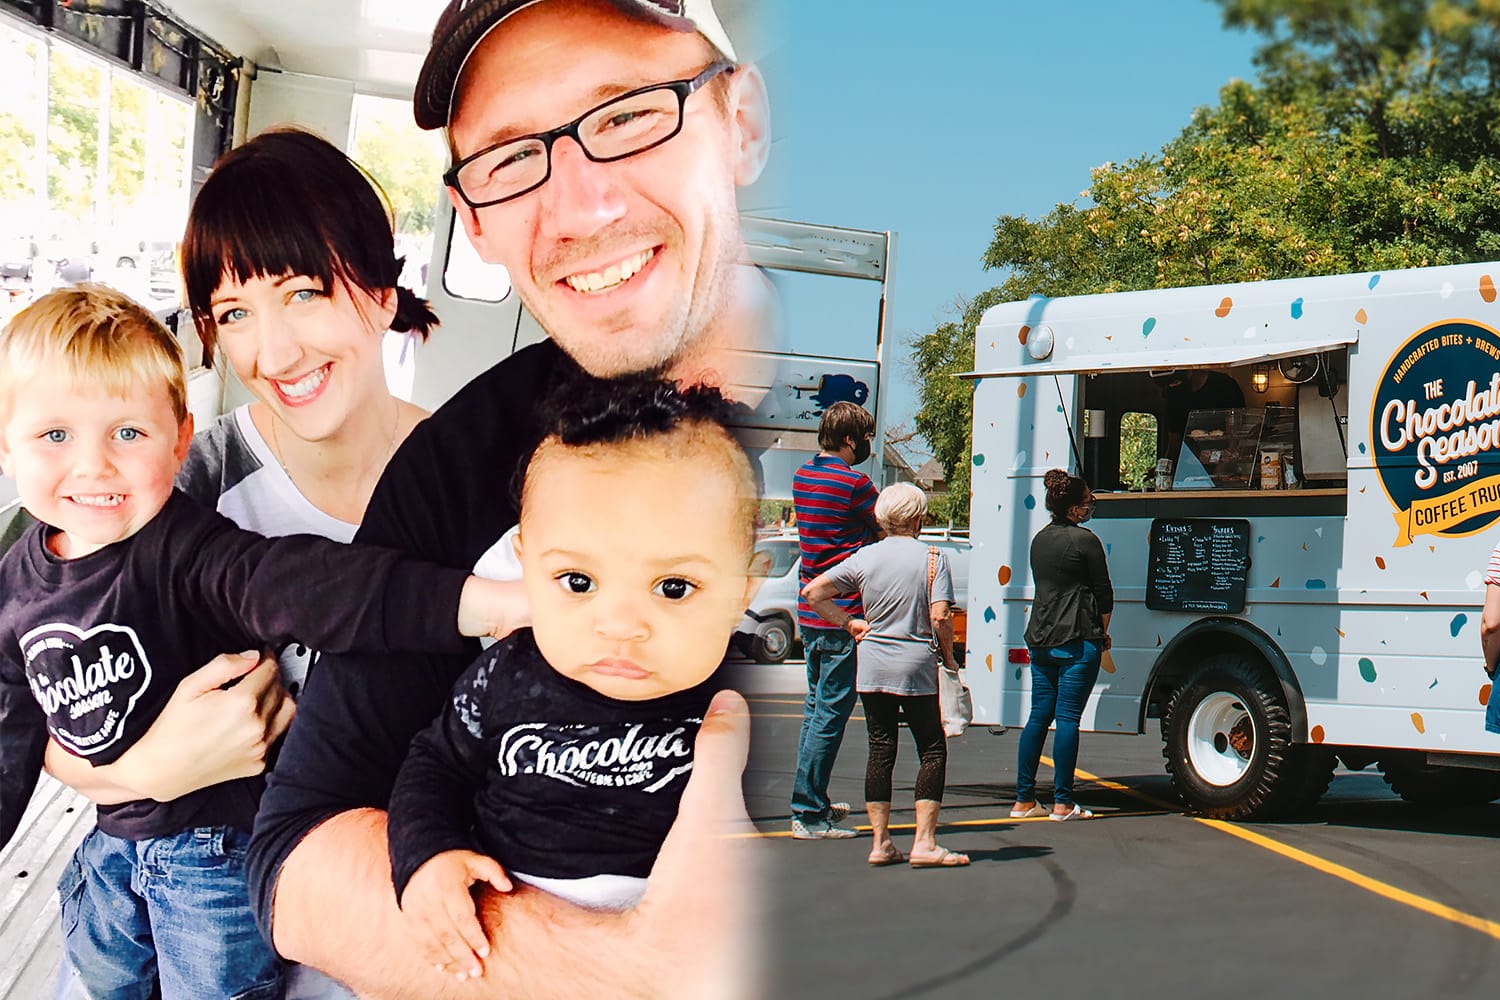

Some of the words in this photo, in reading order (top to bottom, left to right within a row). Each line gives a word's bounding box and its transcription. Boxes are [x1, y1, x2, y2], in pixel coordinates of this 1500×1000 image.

[1393, 338, 1440, 384] HANDCRAFTED
[1441, 334, 1463, 347] BITES
[1465, 336, 1473, 345] +
[1423, 378, 1444, 401] THE
[1443, 470, 1457, 484] EST.
[1457, 460, 1479, 480] 2007
[1415, 495, 1467, 527] COFFEE
[31, 645, 135, 717] hocolate
